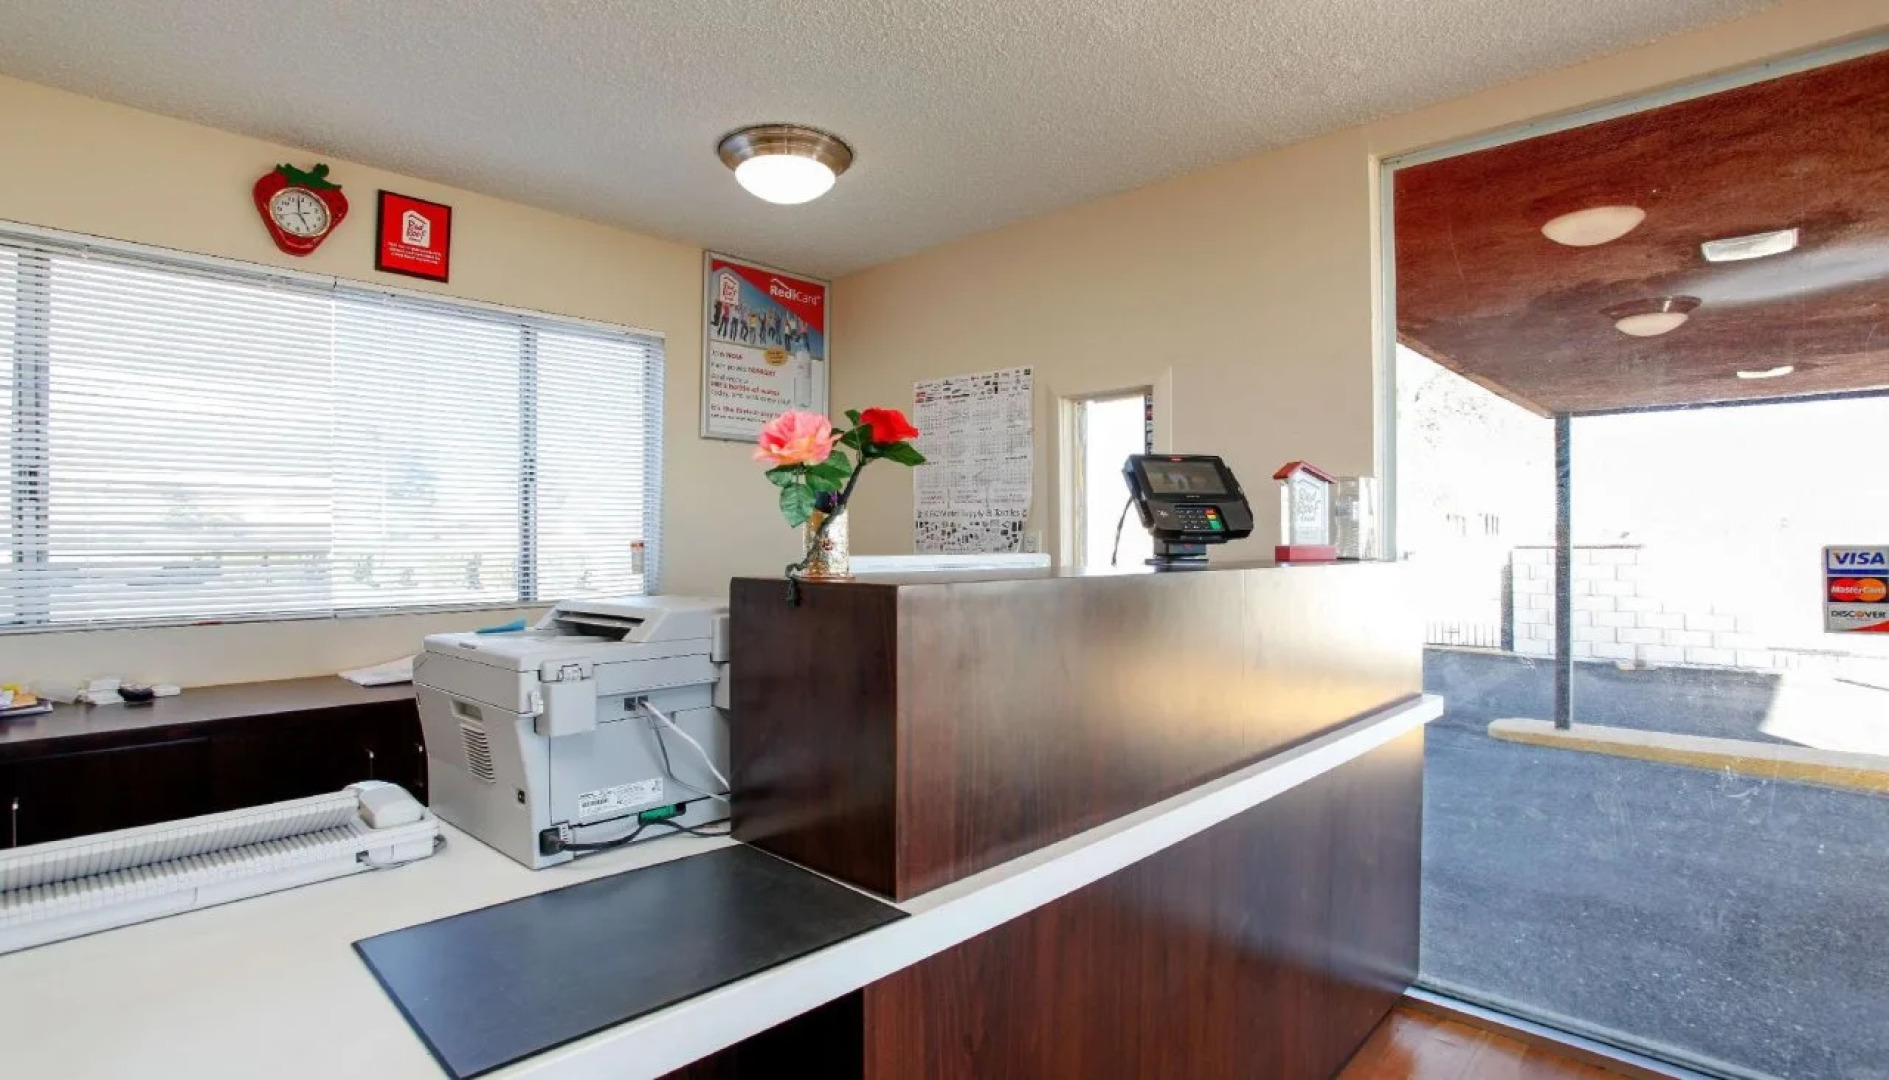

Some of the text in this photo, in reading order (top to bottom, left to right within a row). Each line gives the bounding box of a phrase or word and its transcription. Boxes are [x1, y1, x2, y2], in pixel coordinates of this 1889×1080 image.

[1834, 552, 1885, 565] VISA
[1831, 586, 1886, 594] MasterCard
[1831, 610, 1886, 618] DISCOVER
